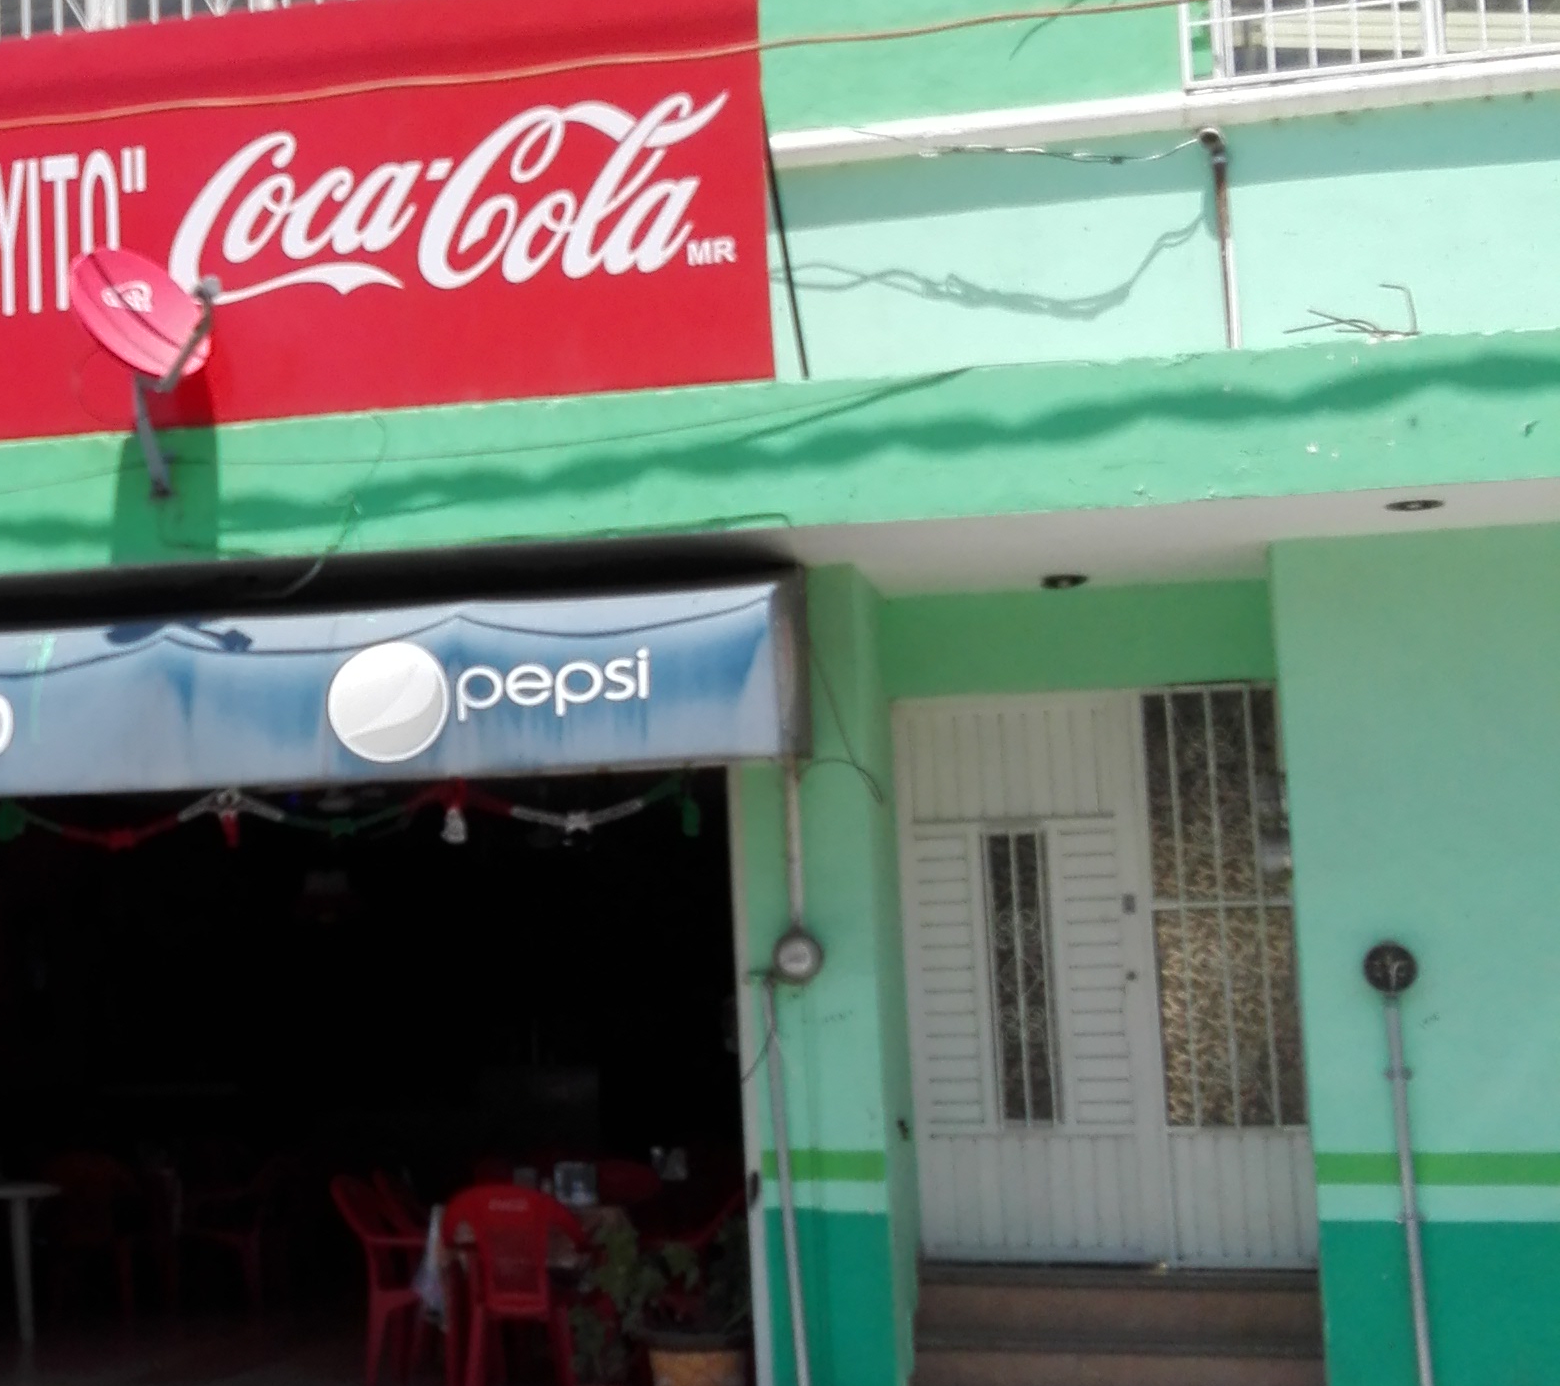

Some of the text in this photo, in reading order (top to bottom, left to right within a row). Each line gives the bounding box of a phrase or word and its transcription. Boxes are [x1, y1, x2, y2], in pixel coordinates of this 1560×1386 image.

[167, 91, 730, 305] Coca-Cola
[686, 236, 737, 266] MR
[456, 647, 651, 722] pepsi
